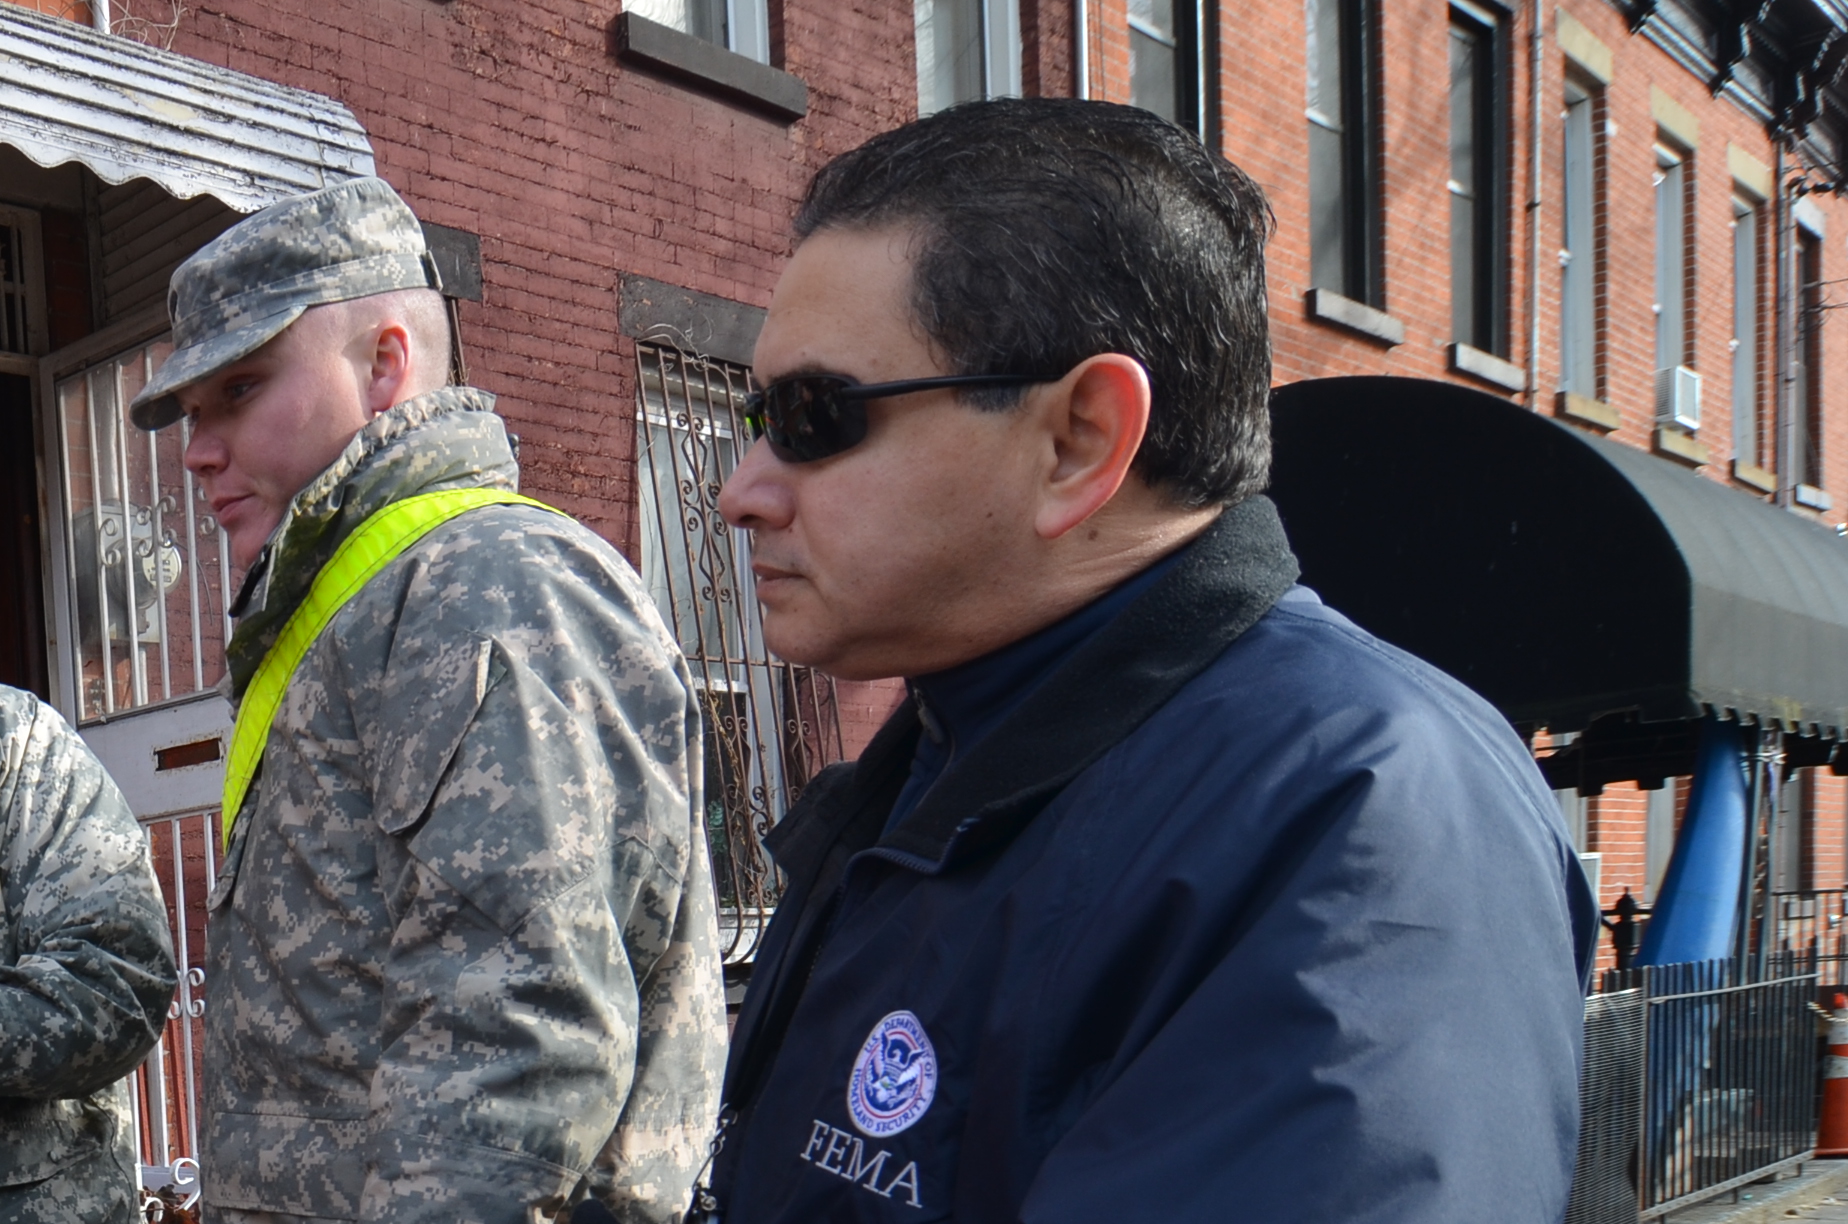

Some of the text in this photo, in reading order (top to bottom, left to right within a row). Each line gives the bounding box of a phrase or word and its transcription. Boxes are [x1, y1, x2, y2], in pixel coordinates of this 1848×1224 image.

[884, 1017, 930, 1058] DEPARTMENT
[924, 1062, 935, 1079] OF
[851, 1069, 926, 1132] HOMELAND SECURITY
[800, 1119, 923, 1208] FEMA
